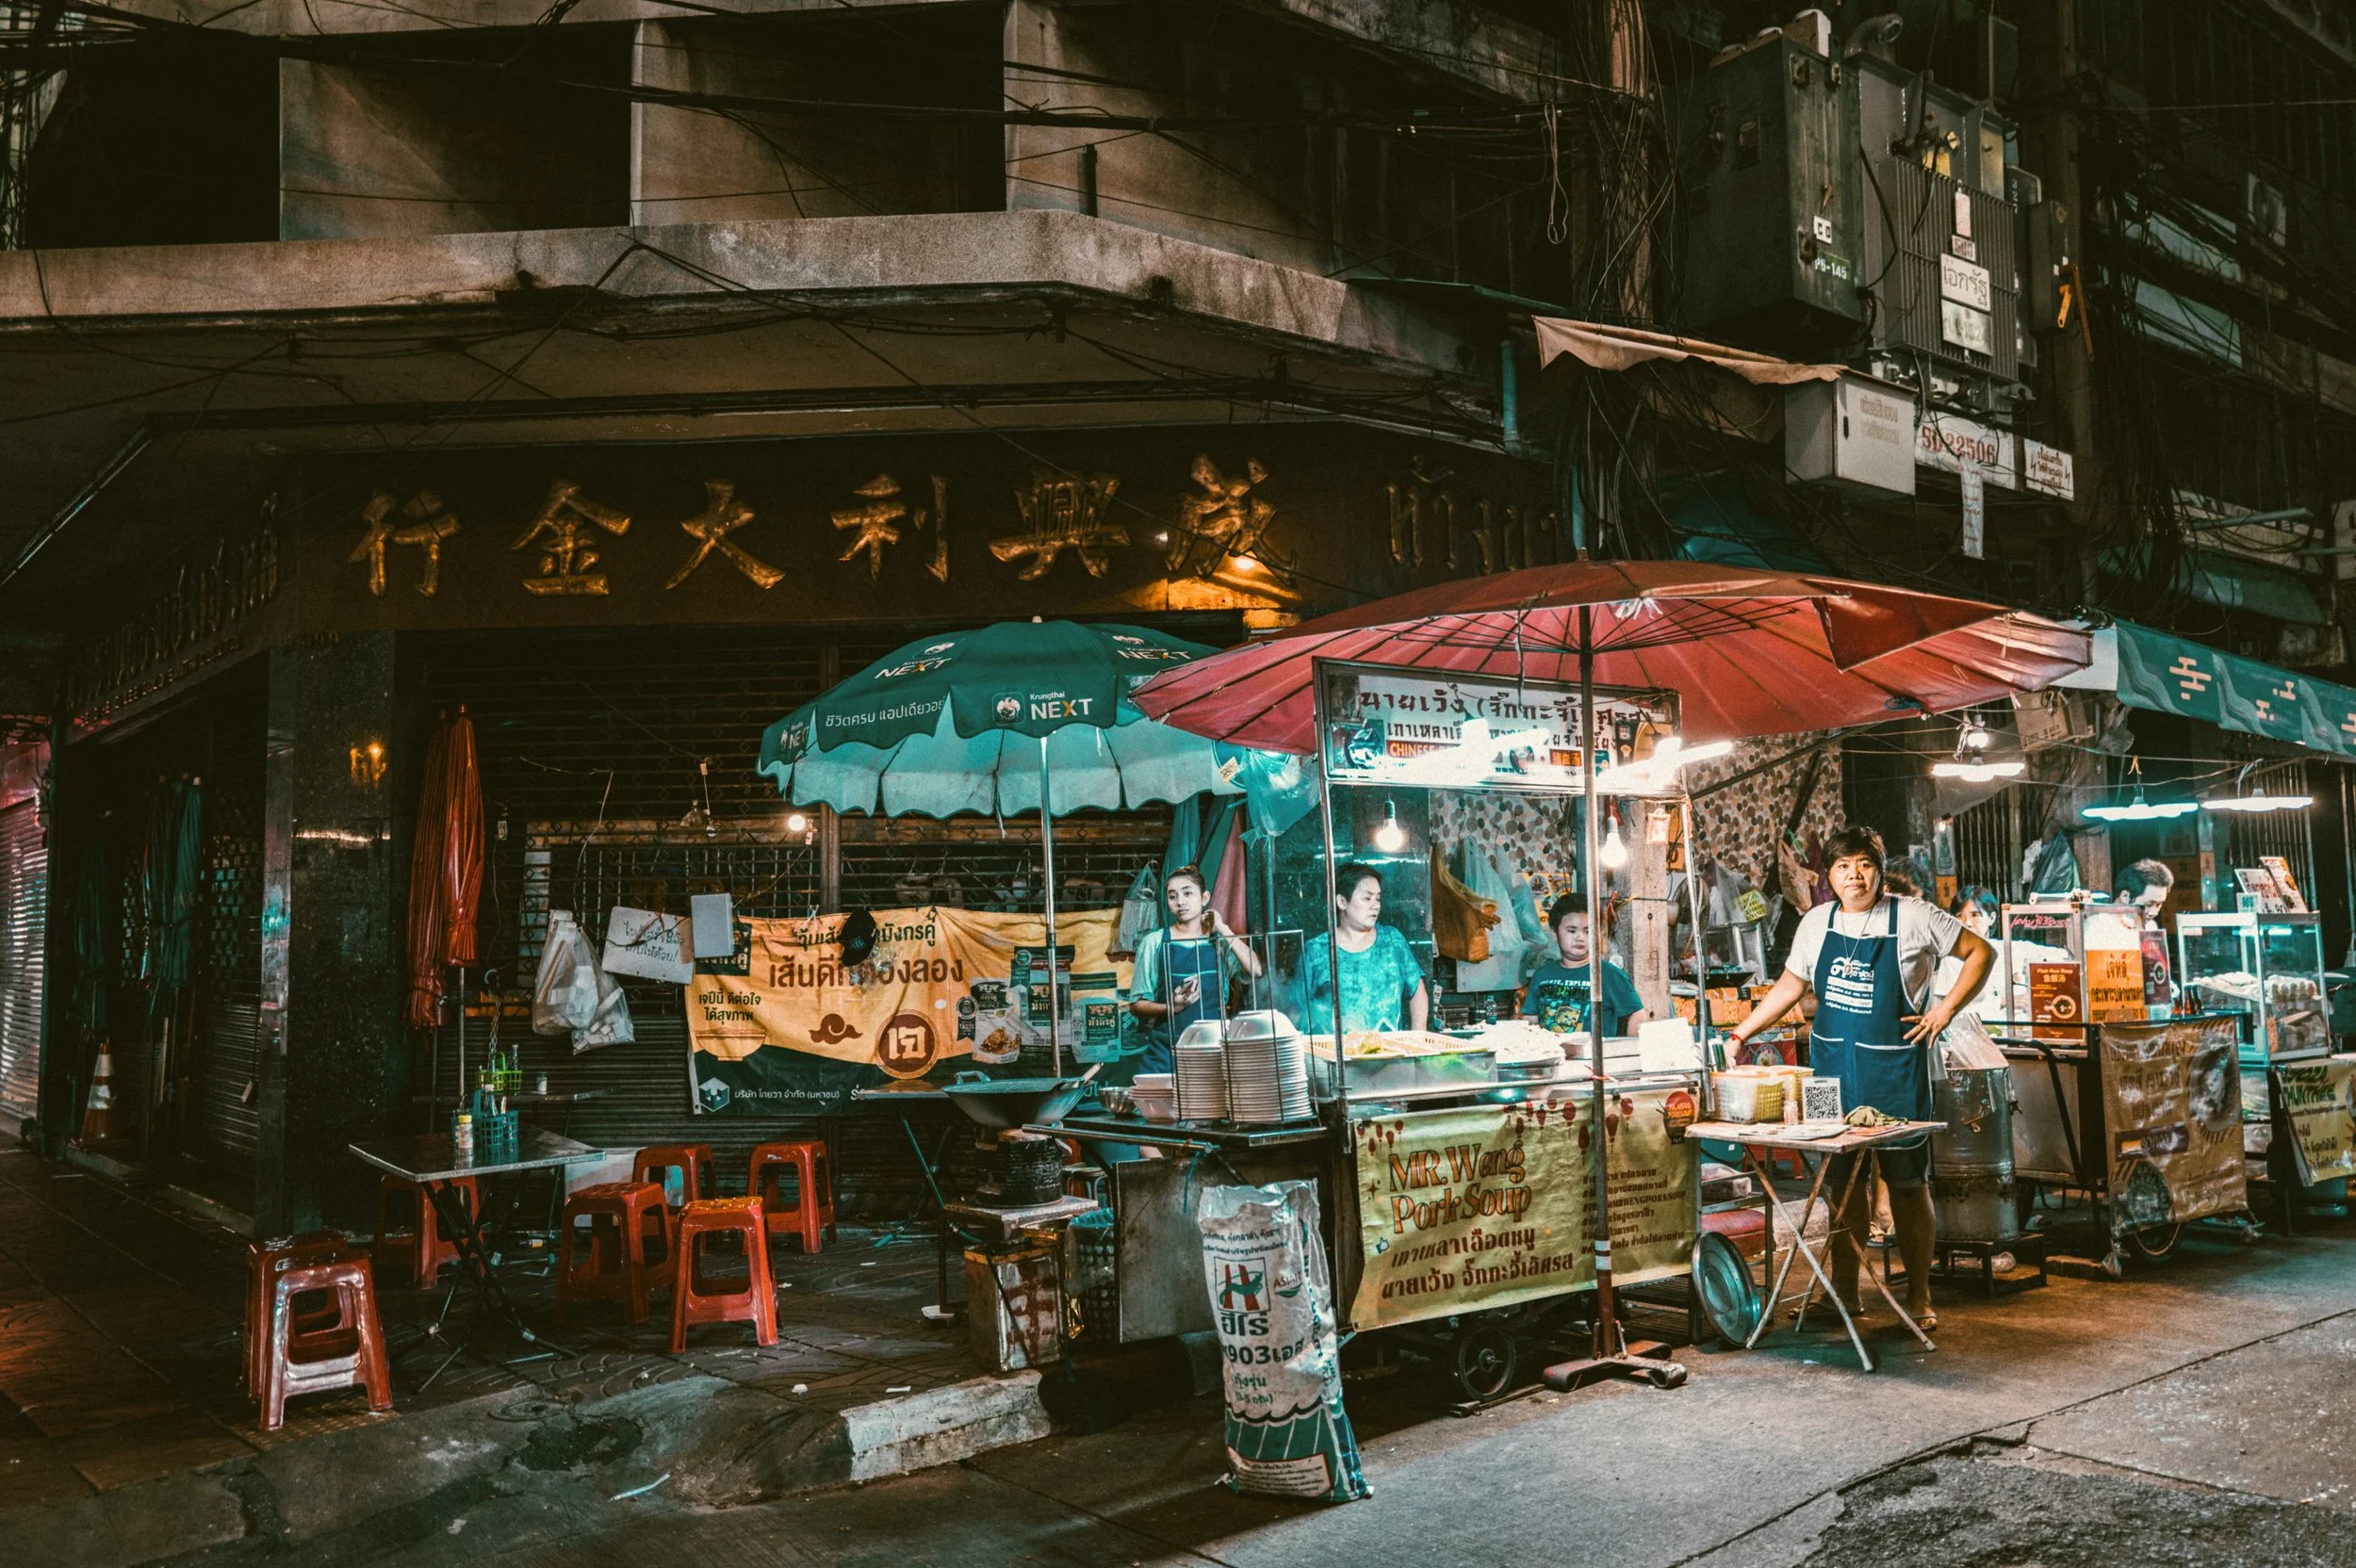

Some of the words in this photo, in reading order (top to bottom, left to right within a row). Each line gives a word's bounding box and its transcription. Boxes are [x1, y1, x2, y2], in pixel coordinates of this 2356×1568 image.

[1117, 649, 1192, 660] NEXT
[874, 657, 953, 678] NEXT
[1029, 691, 1065, 700] Krungthai
[1030, 698, 1093, 720] NEXT
[825, 711, 875, 727] ชีวิตครบ
[704, 1007, 754, 1024] ได้สุขภาพ
[734, 1088, 756, 1098] บริษัท
[784, 1088, 805, 1098] จำกัด
[807, 1090, 840, 1100] (มหาชน)
[1390, 1228, 1536, 1267] เกาเหลาเลือดหมู
[1382, 1267, 1455, 1299] นายเว้ง
